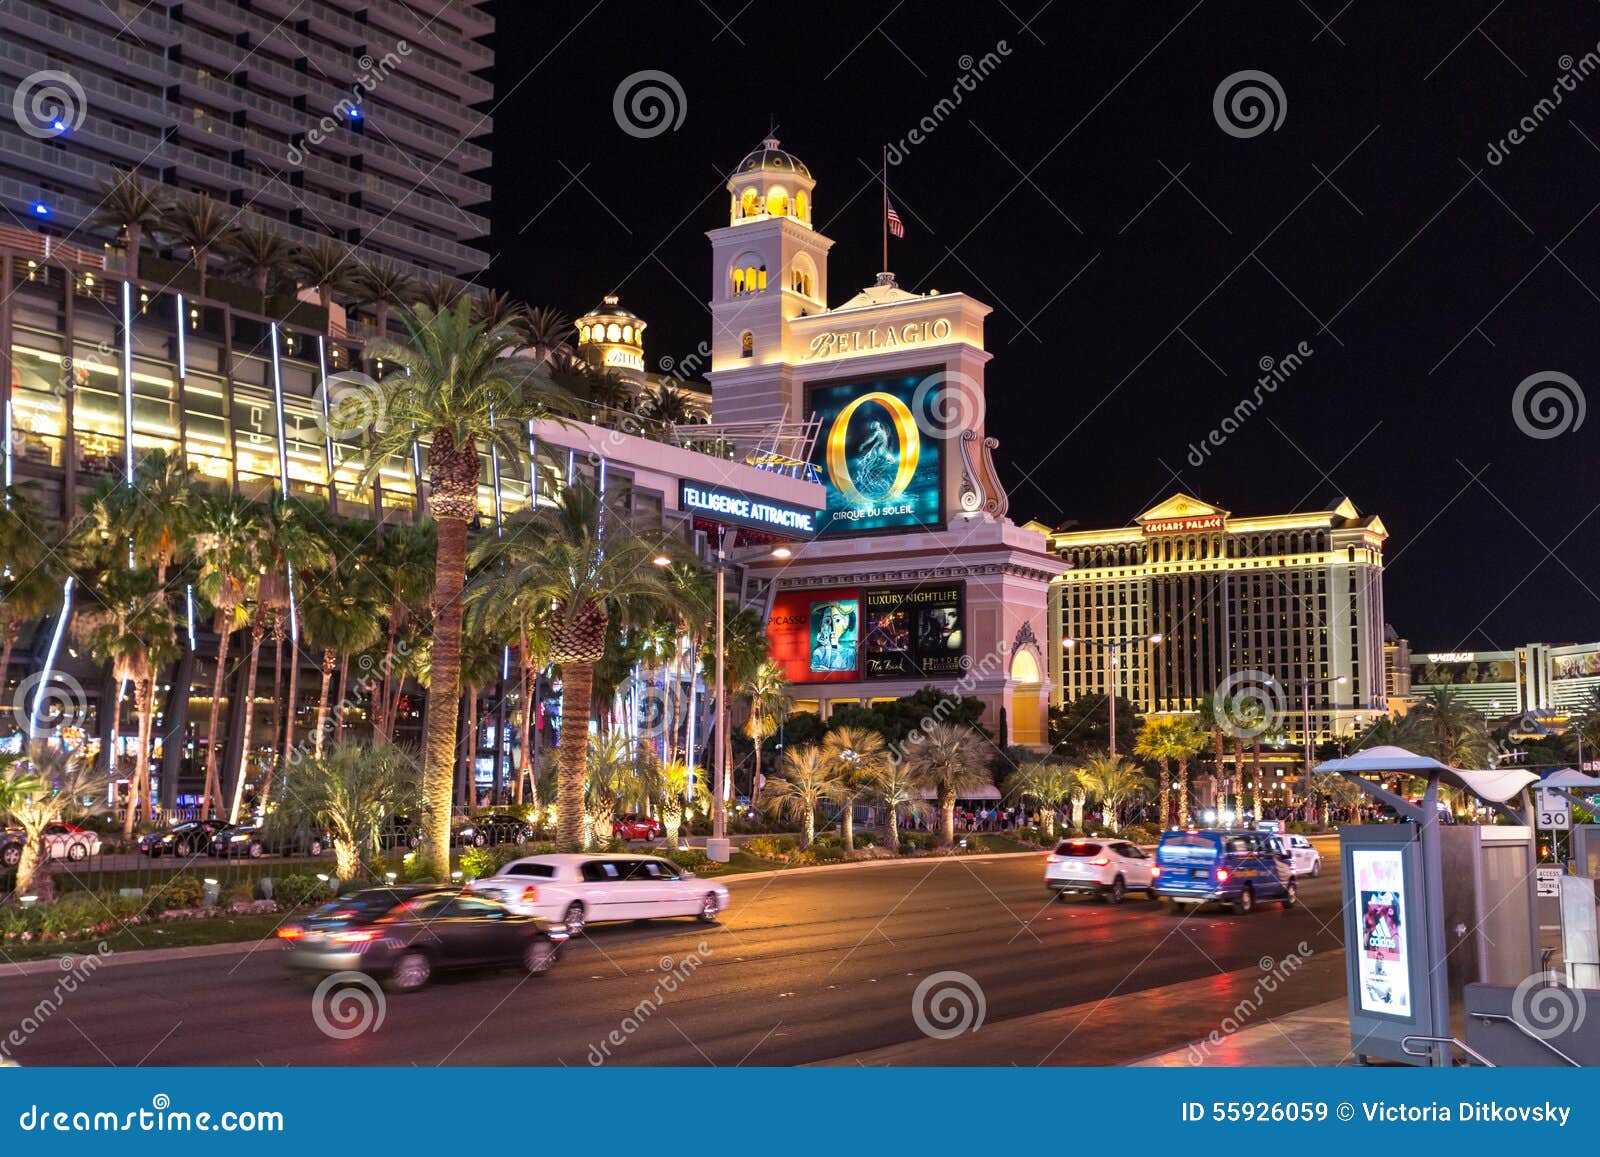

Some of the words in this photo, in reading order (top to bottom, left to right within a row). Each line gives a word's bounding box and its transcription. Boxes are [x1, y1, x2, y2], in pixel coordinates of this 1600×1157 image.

[805, 318, 951, 359] BELLAGIO
[832, 509, 865, 521] CIRQUE
[867, 508, 880, 517] DU
[882, 500, 914, 516] SOLEIL
[1145, 522, 1184, 532] CAESARS
[1186, 518, 1221, 529] PALACE
[868, 594, 903, 605] LUXURY
[905, 590, 957, 602] NIGHTLIFE
[768, 615, 807, 626] PICASSO
[1542, 812, 1565, 825] 30
[1369, 936, 1396, 949] adidas
